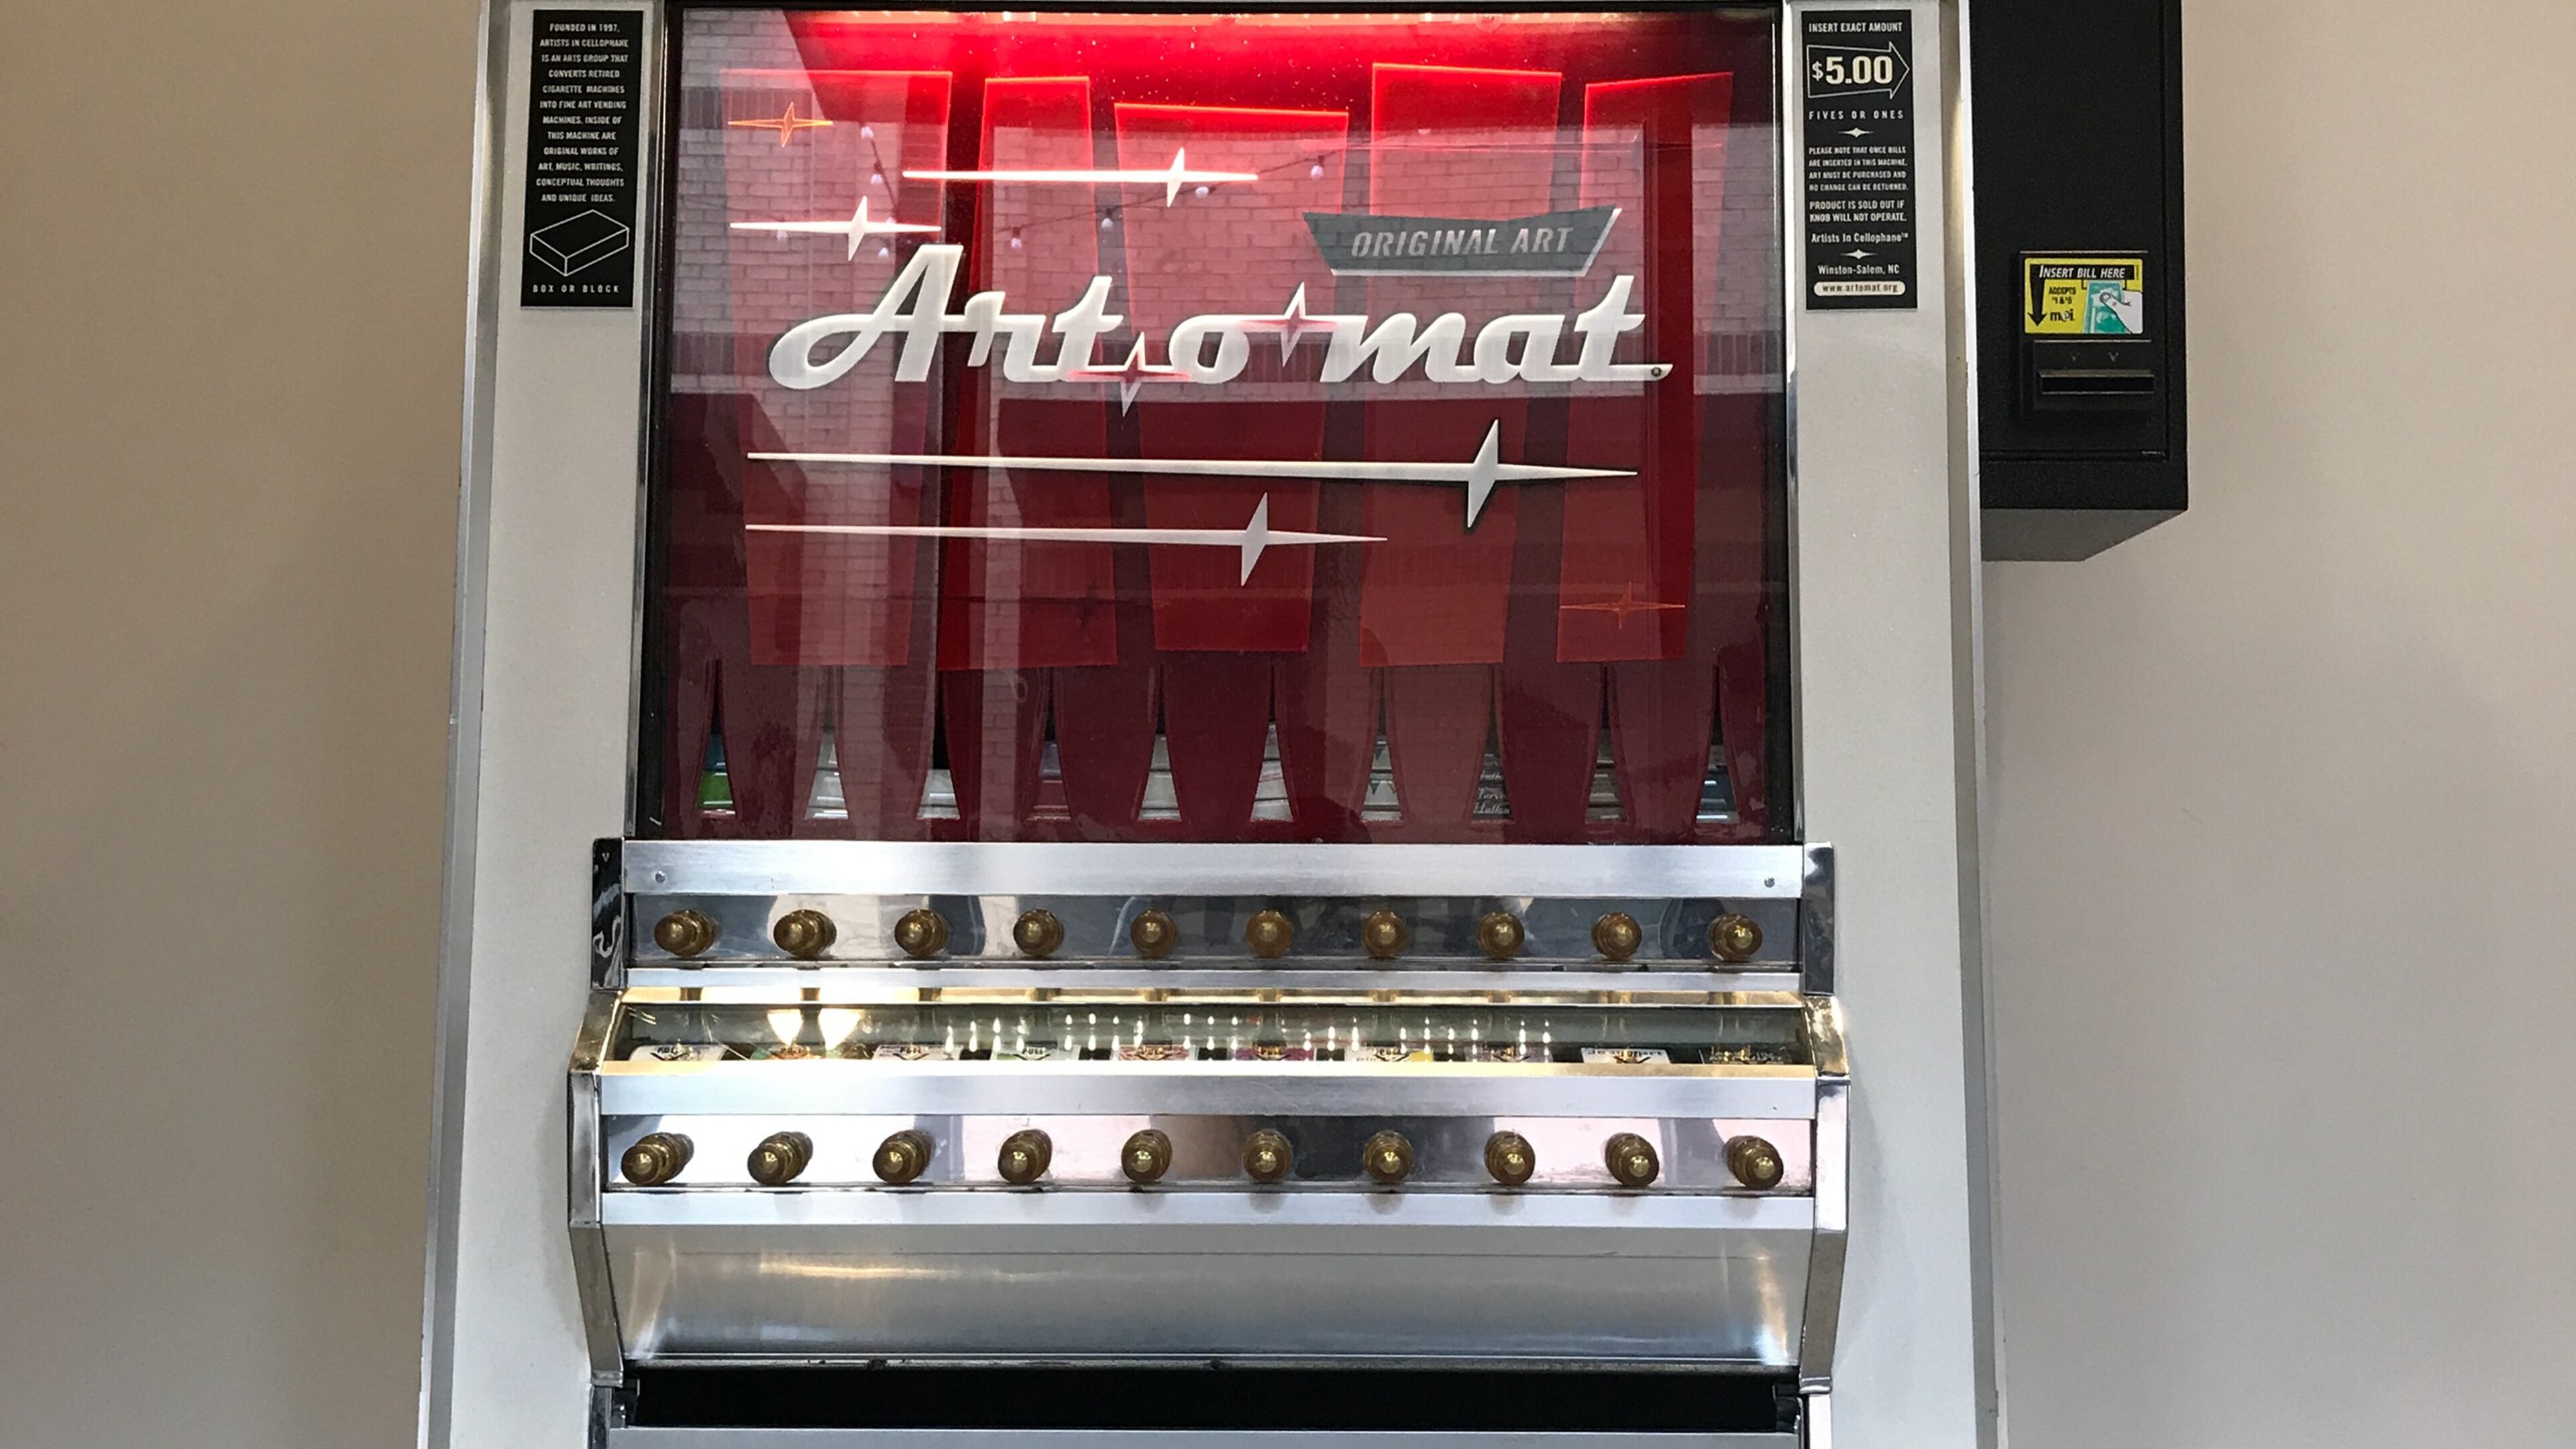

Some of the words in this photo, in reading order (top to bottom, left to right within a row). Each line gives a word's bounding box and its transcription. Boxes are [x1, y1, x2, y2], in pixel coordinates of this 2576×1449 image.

[549, 23, 586, 32] FOUNDED
[588, 23, 596, 32] IN
[1809, 22, 1838, 32] INSERT
[1841, 22, 1866, 32] EXACT
[1869, 22, 1902, 32] AMOUNT
[539, 39, 570, 47] ARTISTS
[572, 39, 580, 47] IN
[582, 39, 629, 47] CELLOPHANE
[541, 54, 549, 62] IS
[551, 54, 561, 62] AN
[563, 54, 581, 62] ARTS
[583, 54, 609, 62] GROUP
[610, 54, 628, 62] THAT
[549, 70, 586, 78] CONVERTS
[588, 70, 620, 78] RETIRED
[1812, 56, 1892, 84] $5.00
[1809, 111, 1843, 119] FIVES
[1851, 111, 1866, 119] OR
[1874, 111, 1903, 119] ONES
[585, 116, 610, 124] INSIDE
[612, 116, 622, 124] OF
[547, 131, 564, 140] THIS
[566, 131, 600, 140] MACHINE
[602, 131, 616, 140] ARE
[544, 147, 578, 155] ORIGINAL
[580, 147, 606, 155] WORKS
[608, 147, 619, 155] OF
[536, 178, 584, 186] CONCEPTUAL
[586, 178, 625, 186] THOUGHTS
[541, 194, 556, 202] AND
[559, 194, 586, 202] UNIQUE
[1810, 201, 1845, 209] PRODUCT
[1848, 201, 1856, 209] IS
[1858, 201, 1878, 209] SOLD
[1880, 201, 1894, 209] OUT
[1897, 201, 1904, 209] IF
[1810, 214, 1830, 222] KNOB
[1832, 213, 1851, 221] WILL
[1854, 213, 1868, 221] NOT
[1350, 227, 1499, 257] ORIGINAL
[1510, 227, 1574, 253] ART
[1811, 233, 1839, 243] Artists
[1843, 233, 1851, 242] In
[1888, 264, 1899, 273] NC
[2077, 268, 2096, 278] BILL
[2100, 268, 2125, 278] HERE
[533, 284, 553, 292] BOX
[561, 284, 574, 292] OR
[583, 284, 619, 292] BLOCK
